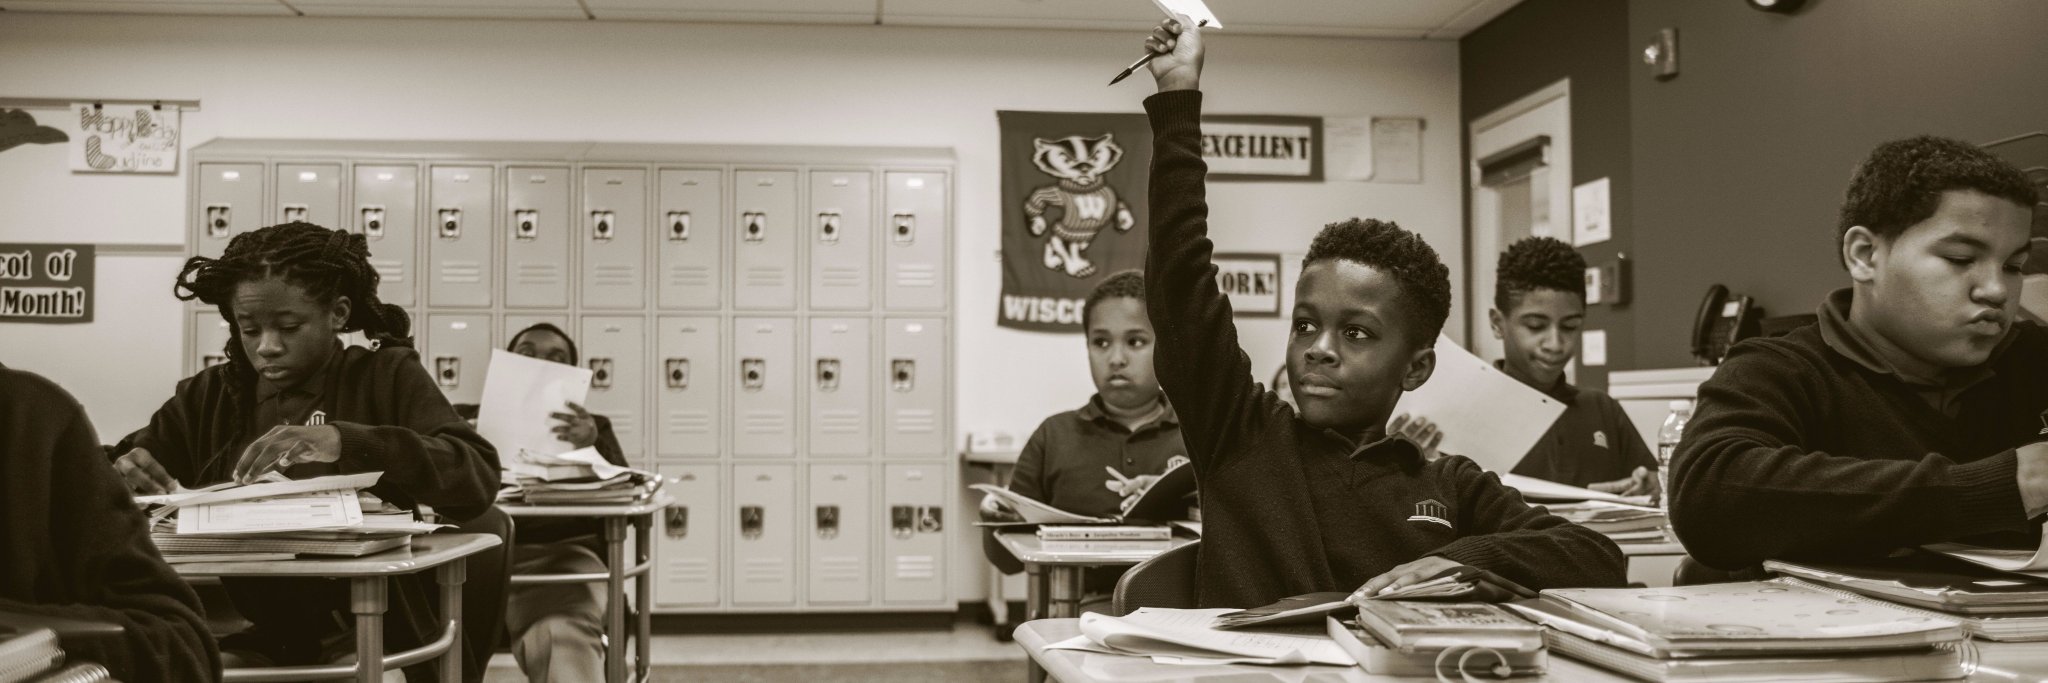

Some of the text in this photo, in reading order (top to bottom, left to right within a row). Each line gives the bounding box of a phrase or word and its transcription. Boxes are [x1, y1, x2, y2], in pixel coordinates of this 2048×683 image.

[81, 106, 135, 143] Happy
[1201, 134, 1310, 159] EXCELLENT
[48, 252, 72, 277] of
[3, 289, 84, 315] Month!
